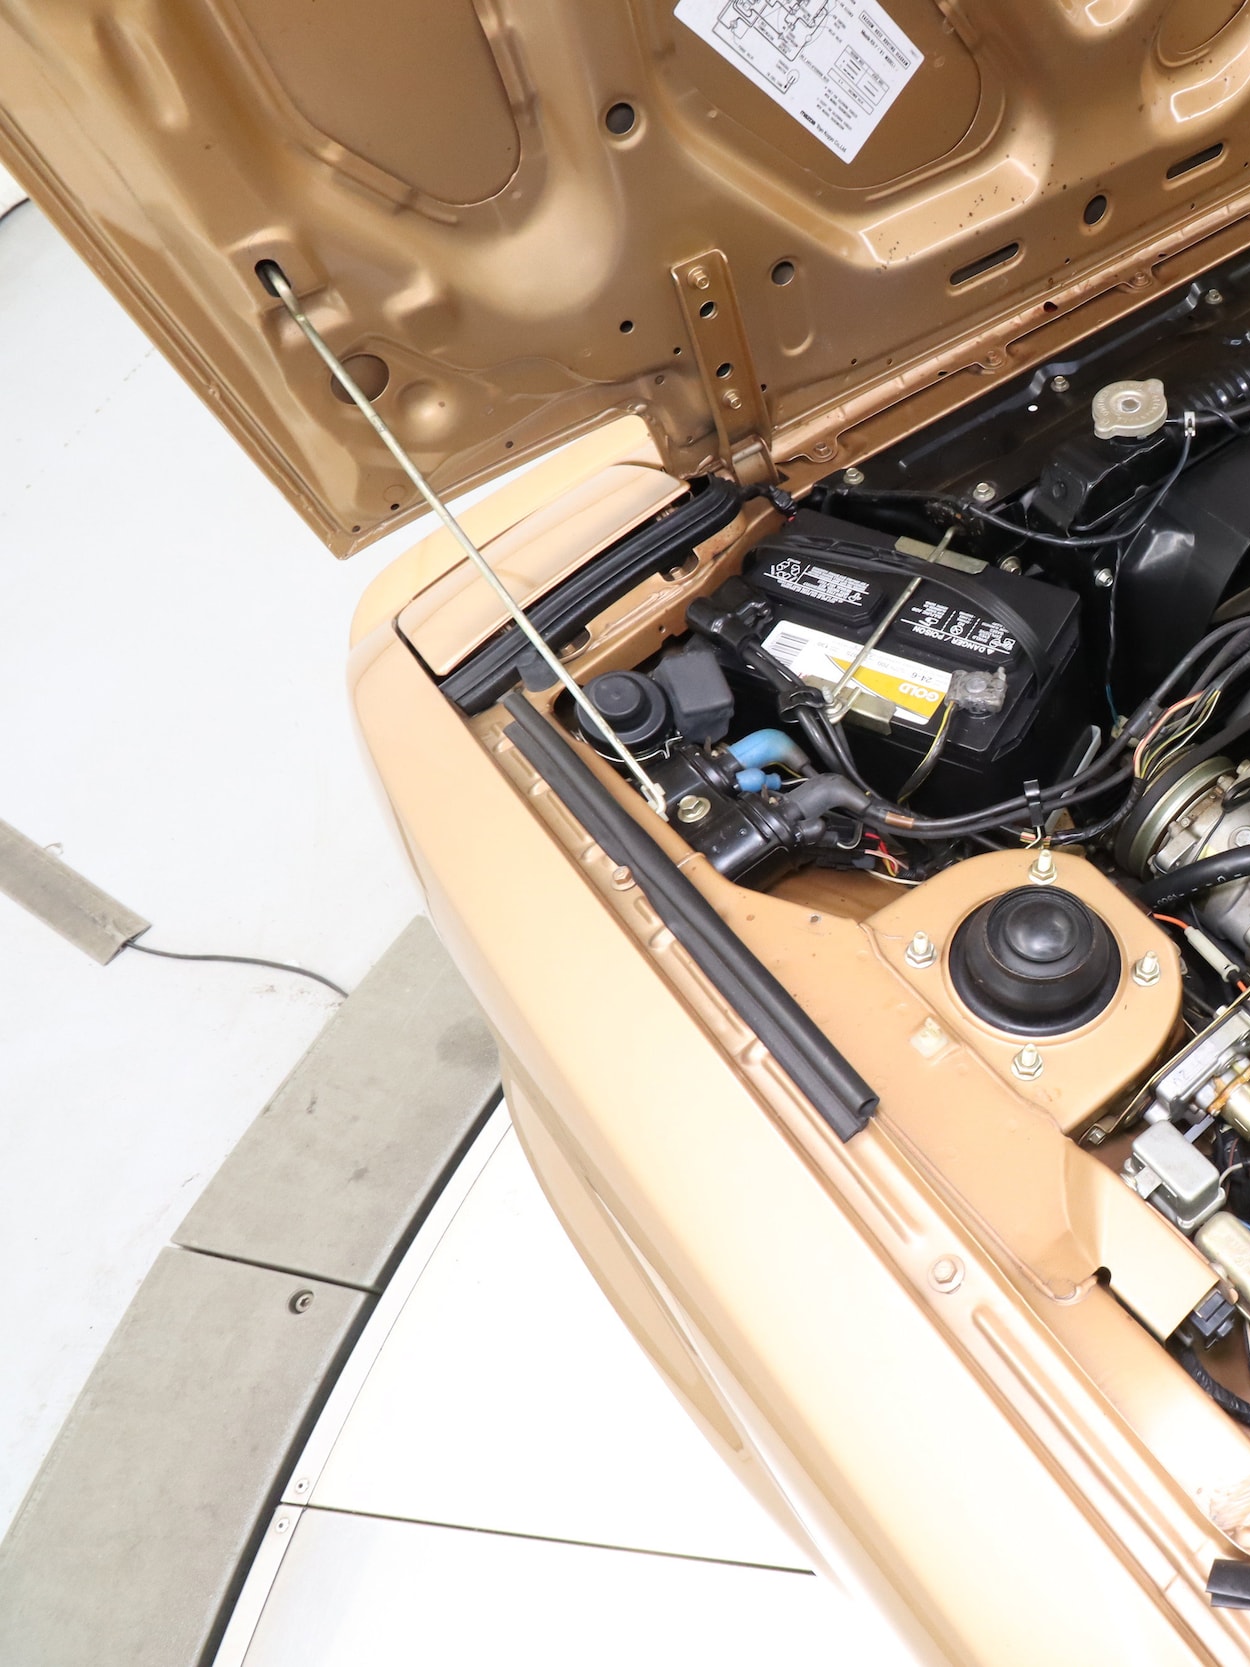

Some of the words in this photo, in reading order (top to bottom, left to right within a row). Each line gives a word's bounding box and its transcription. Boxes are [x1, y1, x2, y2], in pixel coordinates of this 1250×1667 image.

[914, 625, 944, 640] POISON
[951, 636, 986, 653] DANGER
[899, 682, 939, 702] GOLD
